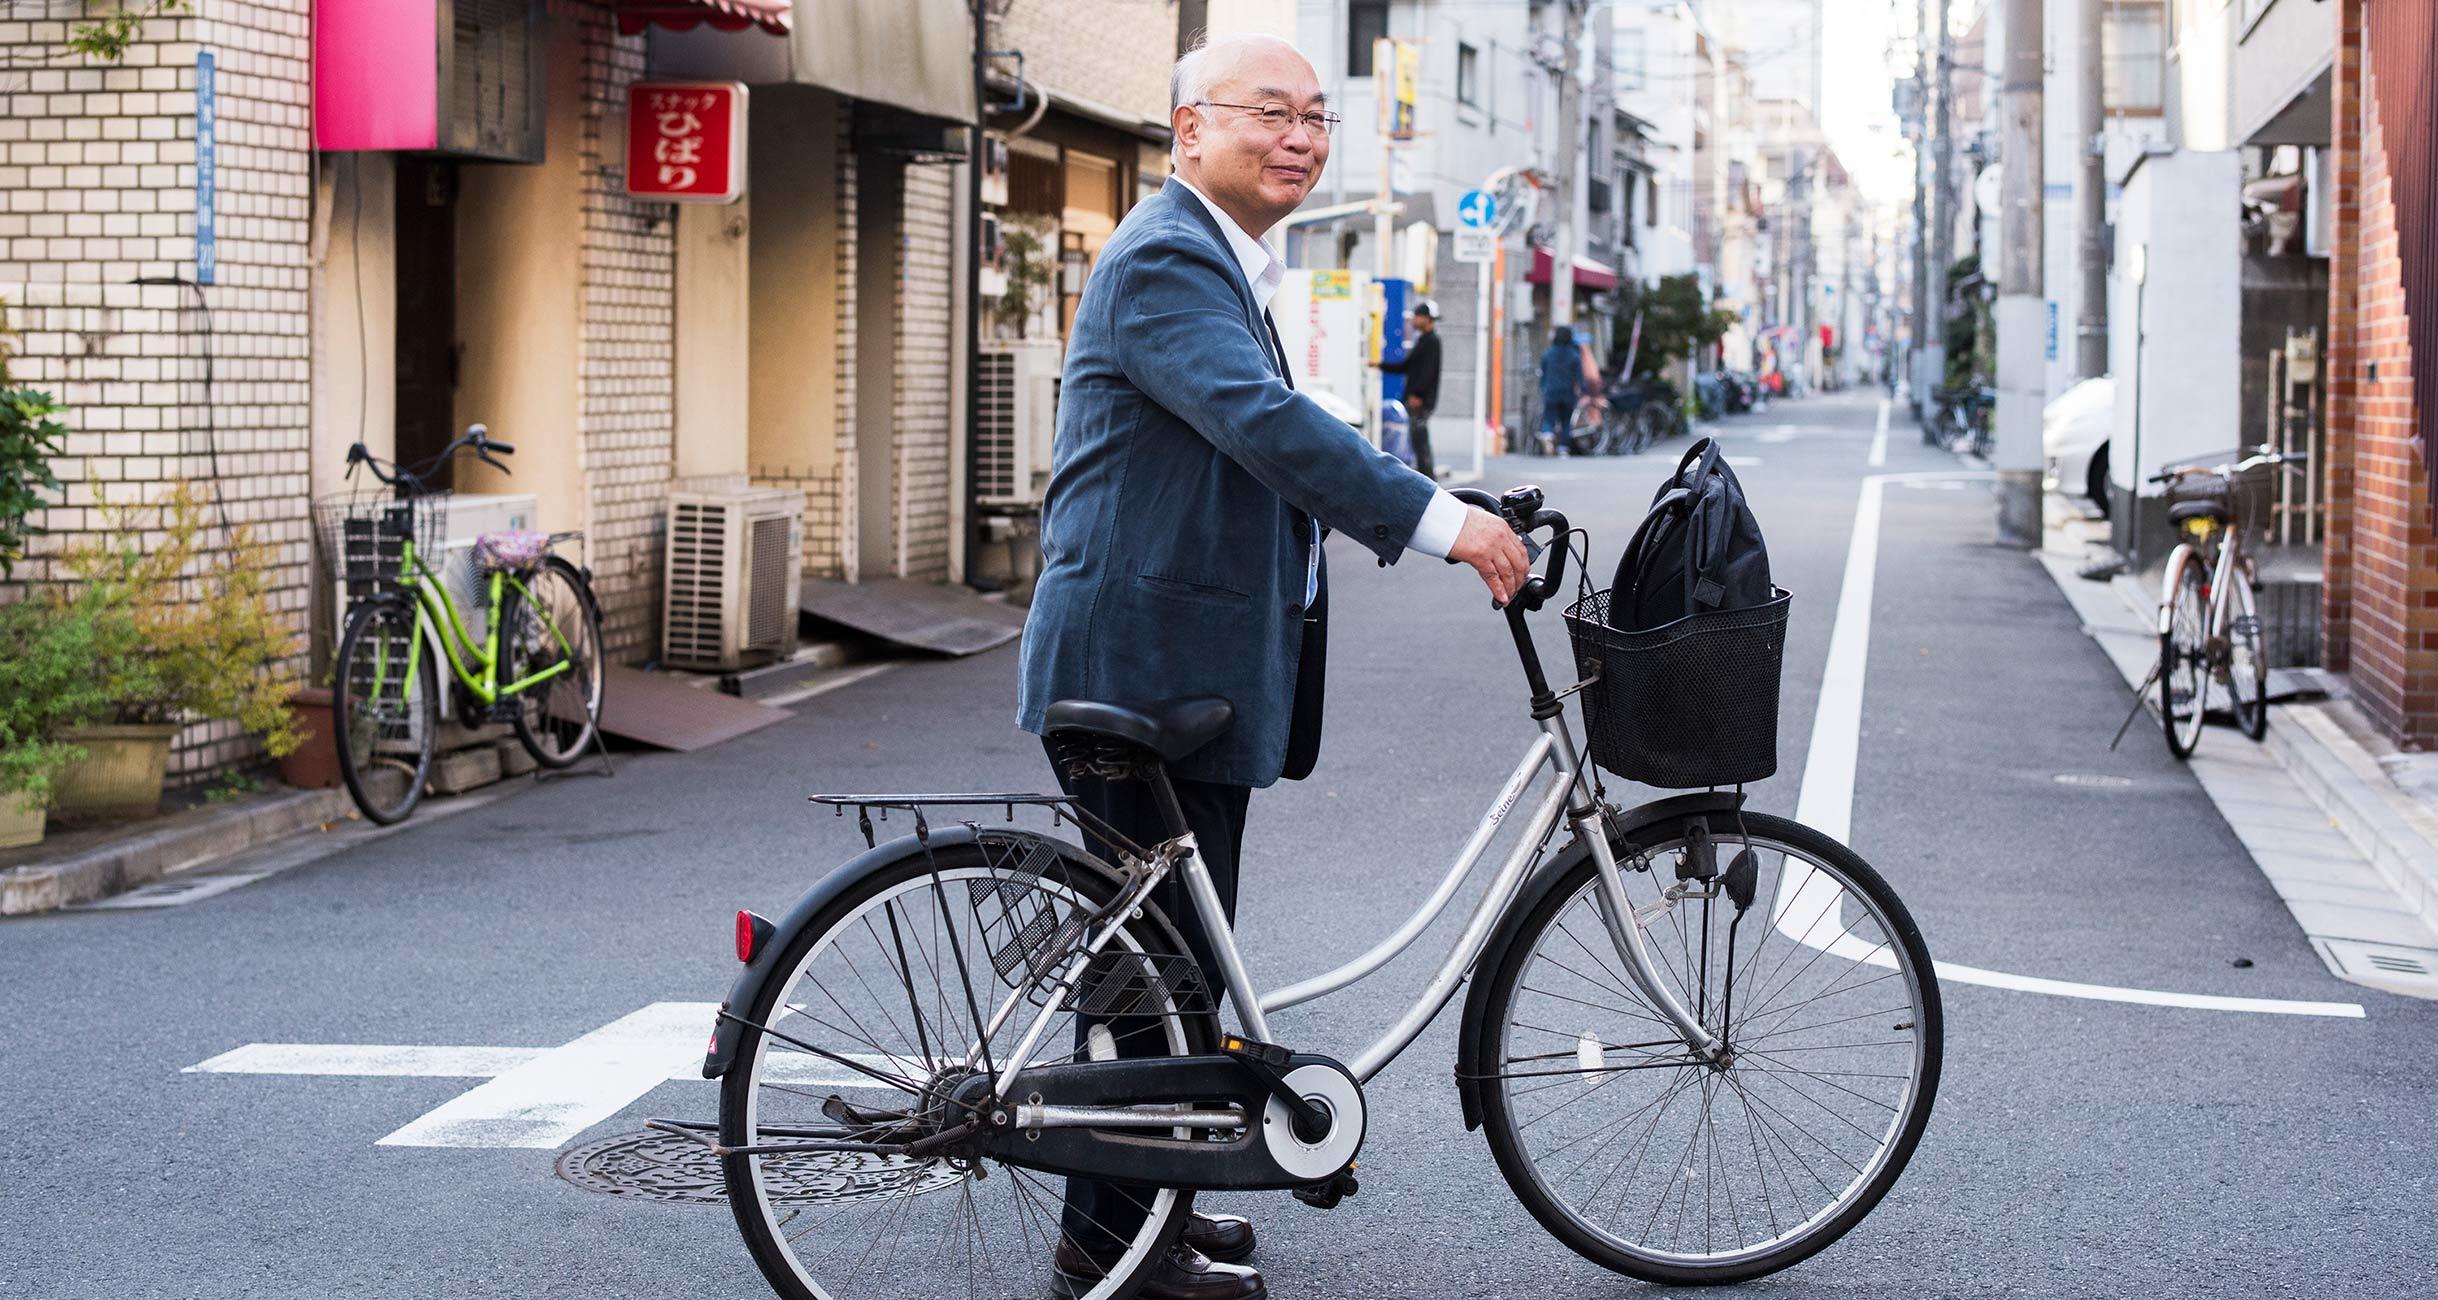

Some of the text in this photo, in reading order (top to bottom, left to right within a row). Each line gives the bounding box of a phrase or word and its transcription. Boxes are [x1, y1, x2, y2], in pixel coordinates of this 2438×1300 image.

[649, 92, 717, 112] スナック
[655, 111, 704, 191] ひばり
[1489, 794, 1515, 826] Seine
